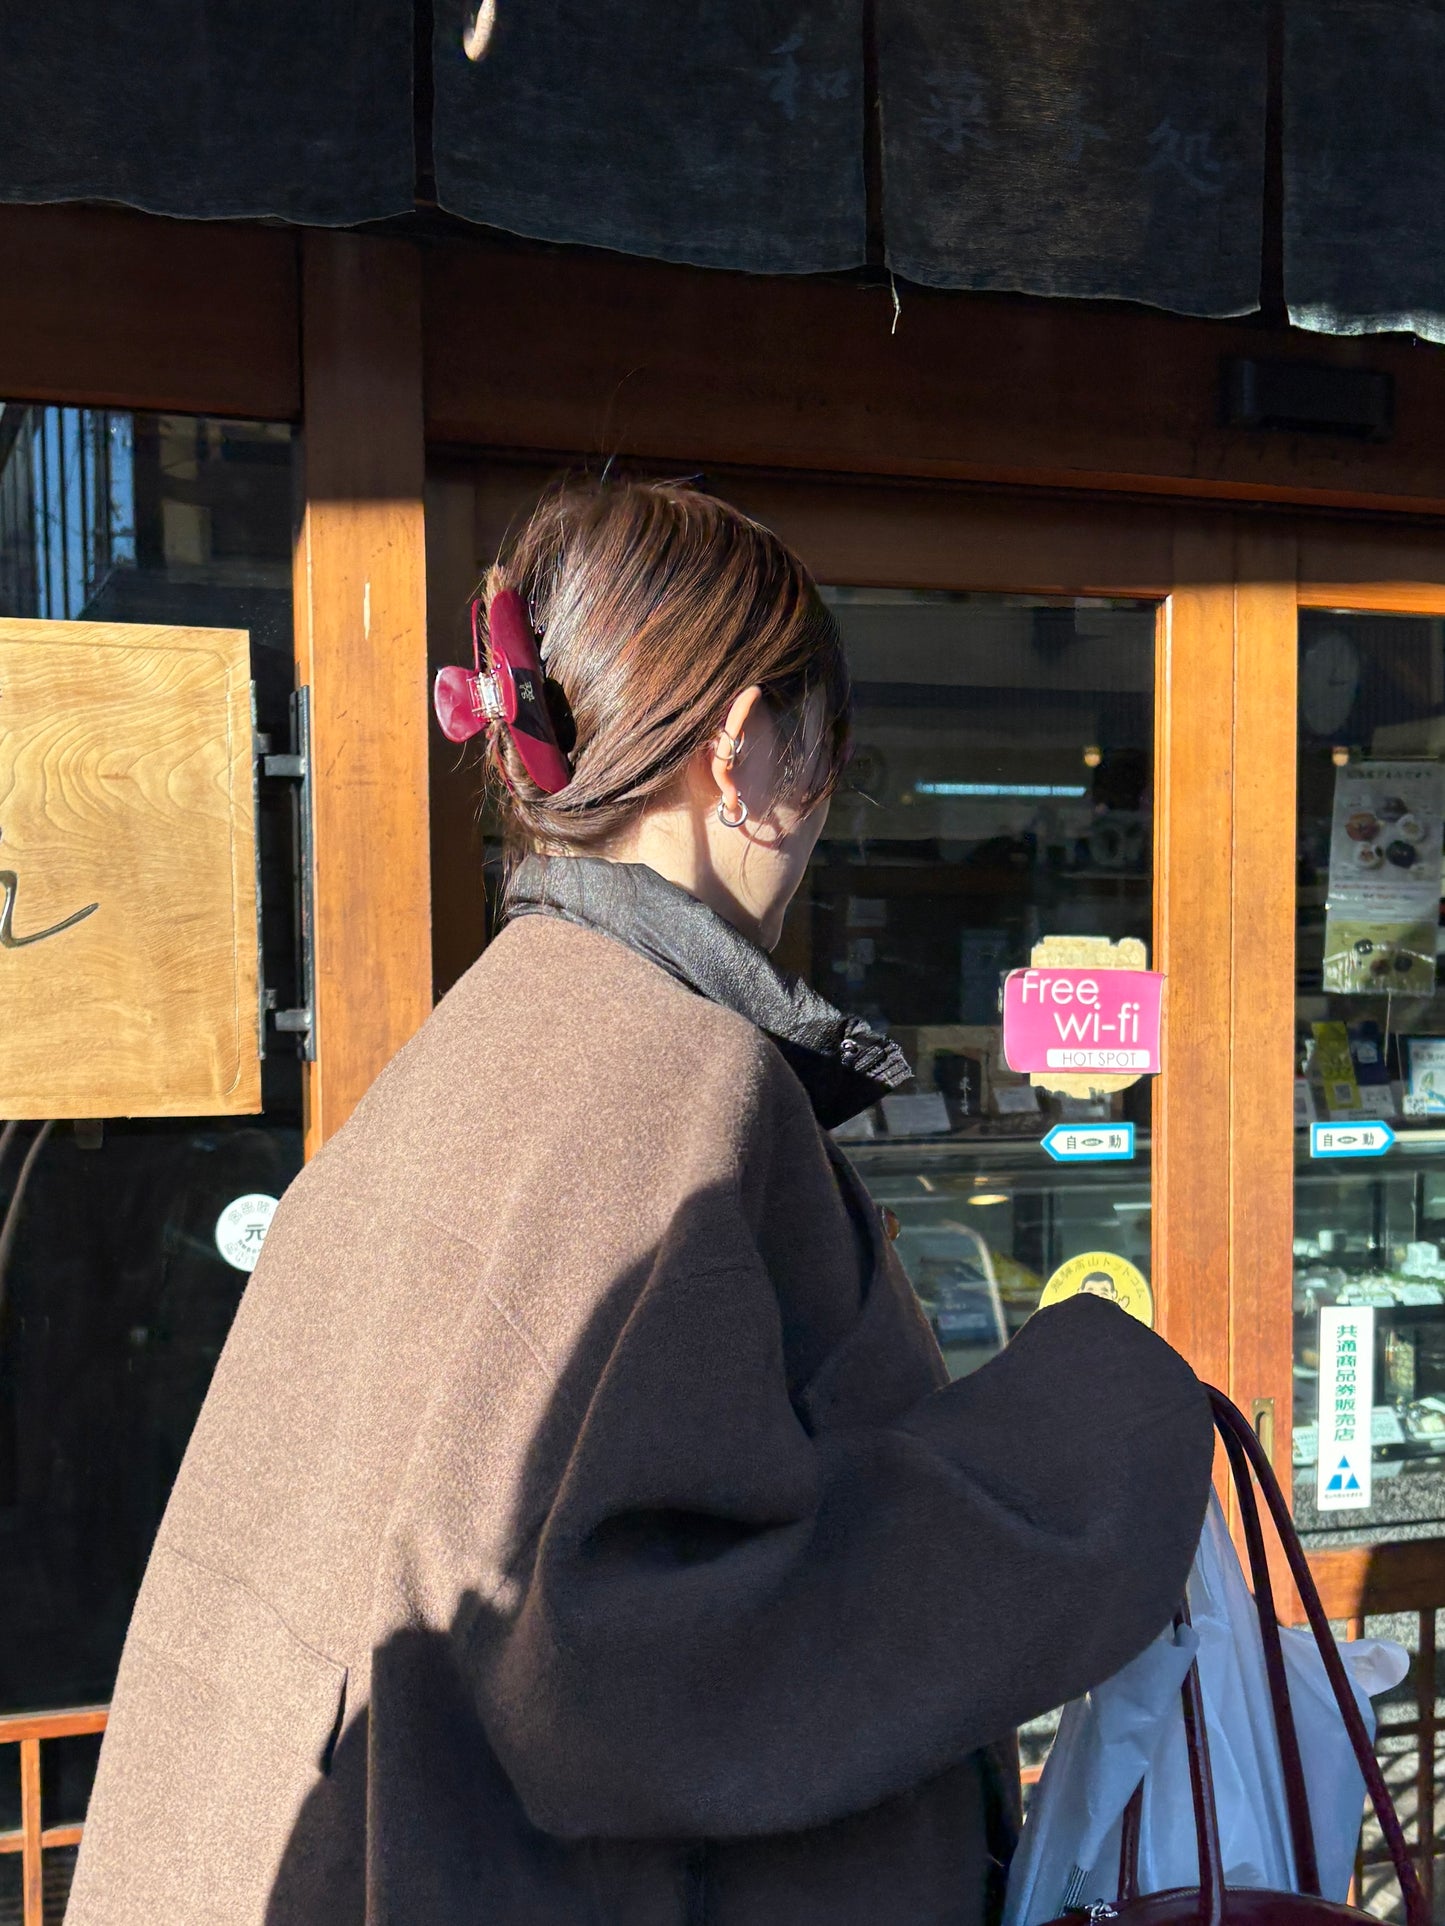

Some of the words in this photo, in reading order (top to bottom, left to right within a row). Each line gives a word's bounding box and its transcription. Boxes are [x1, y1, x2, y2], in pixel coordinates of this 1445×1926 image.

[1021, 970, 1099, 1005] Free
[1062, 1052, 1094, 1066] HOT
[1098, 1052, 1137, 1066] SPOT
[1333, 1324, 1358, 1442] 共通商品券販売店
